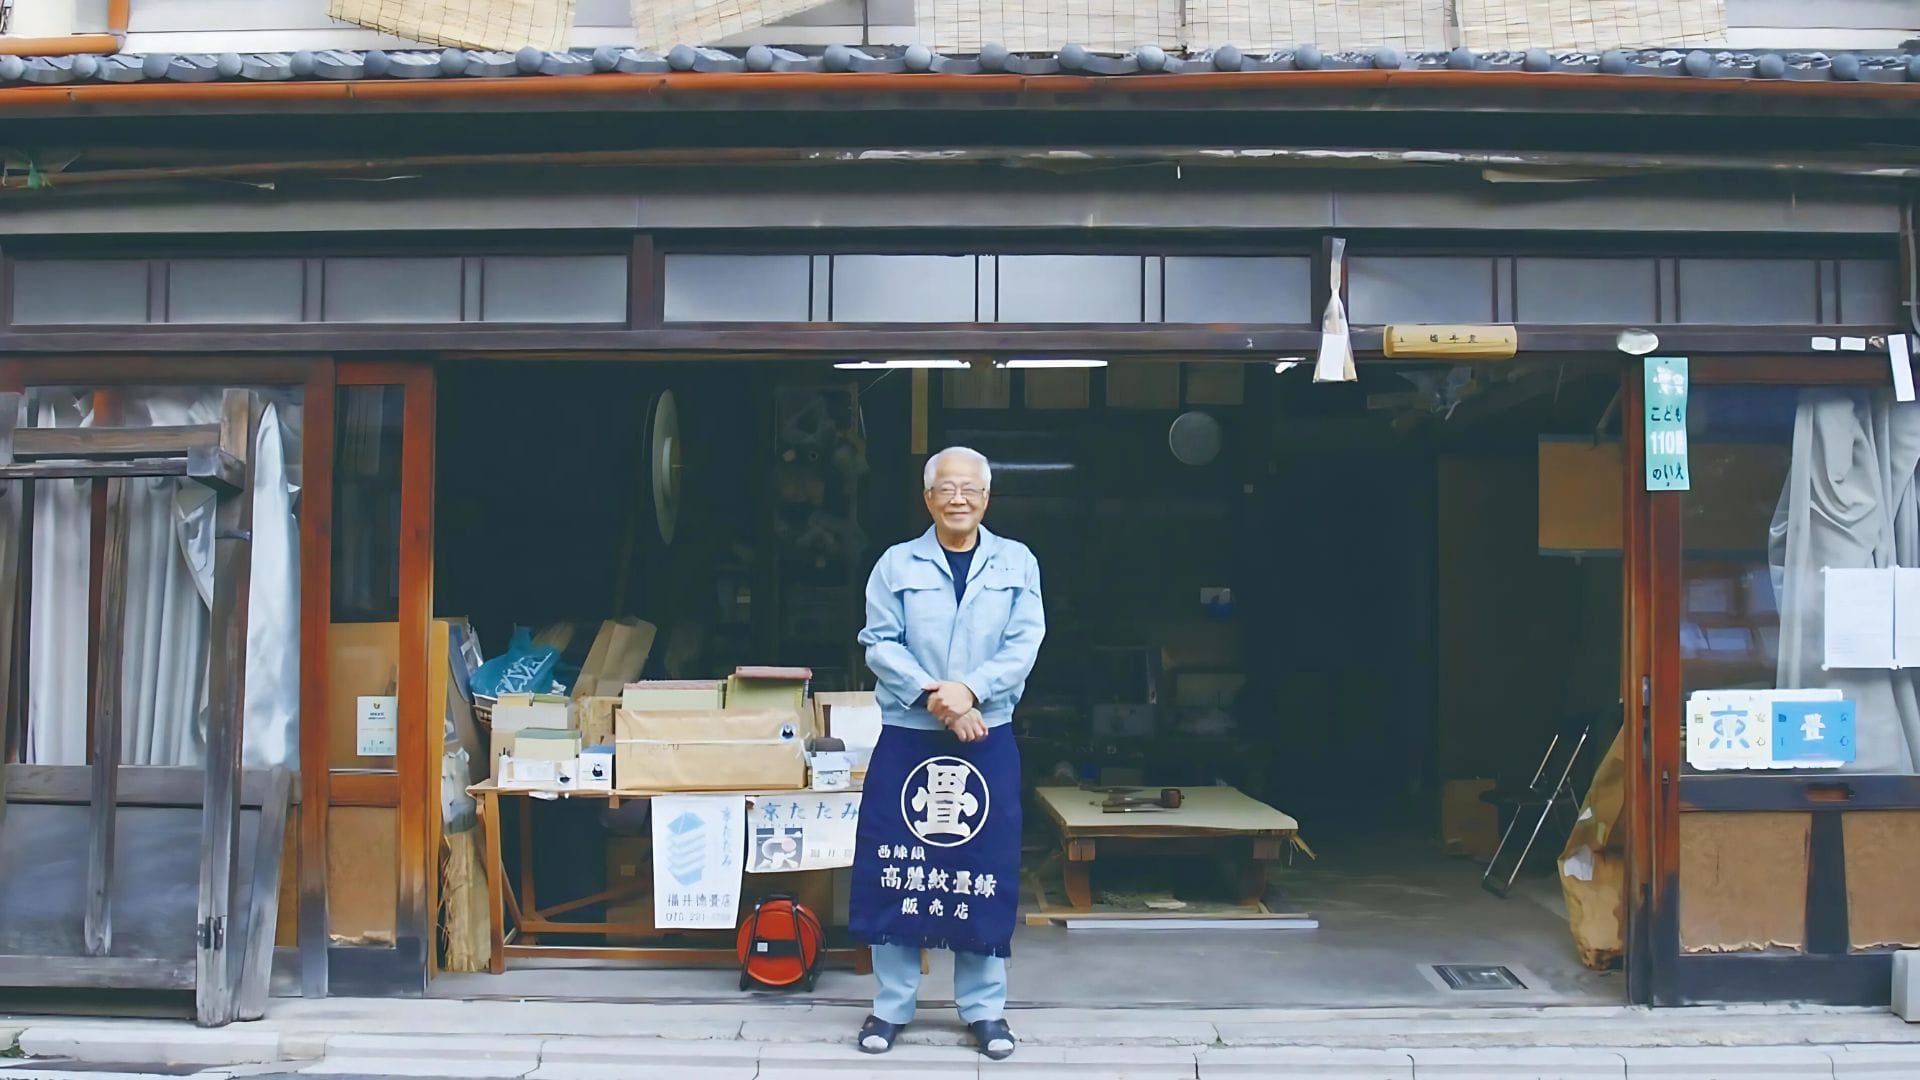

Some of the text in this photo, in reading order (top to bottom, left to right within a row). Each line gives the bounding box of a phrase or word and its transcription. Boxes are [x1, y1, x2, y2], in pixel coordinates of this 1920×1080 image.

[1650, 404, 1683, 423] こども
[1652, 462, 1685, 481] のいえ
[760, 801, 858, 822] 京たたみ
[901, 896, 970, 920] 販売店
